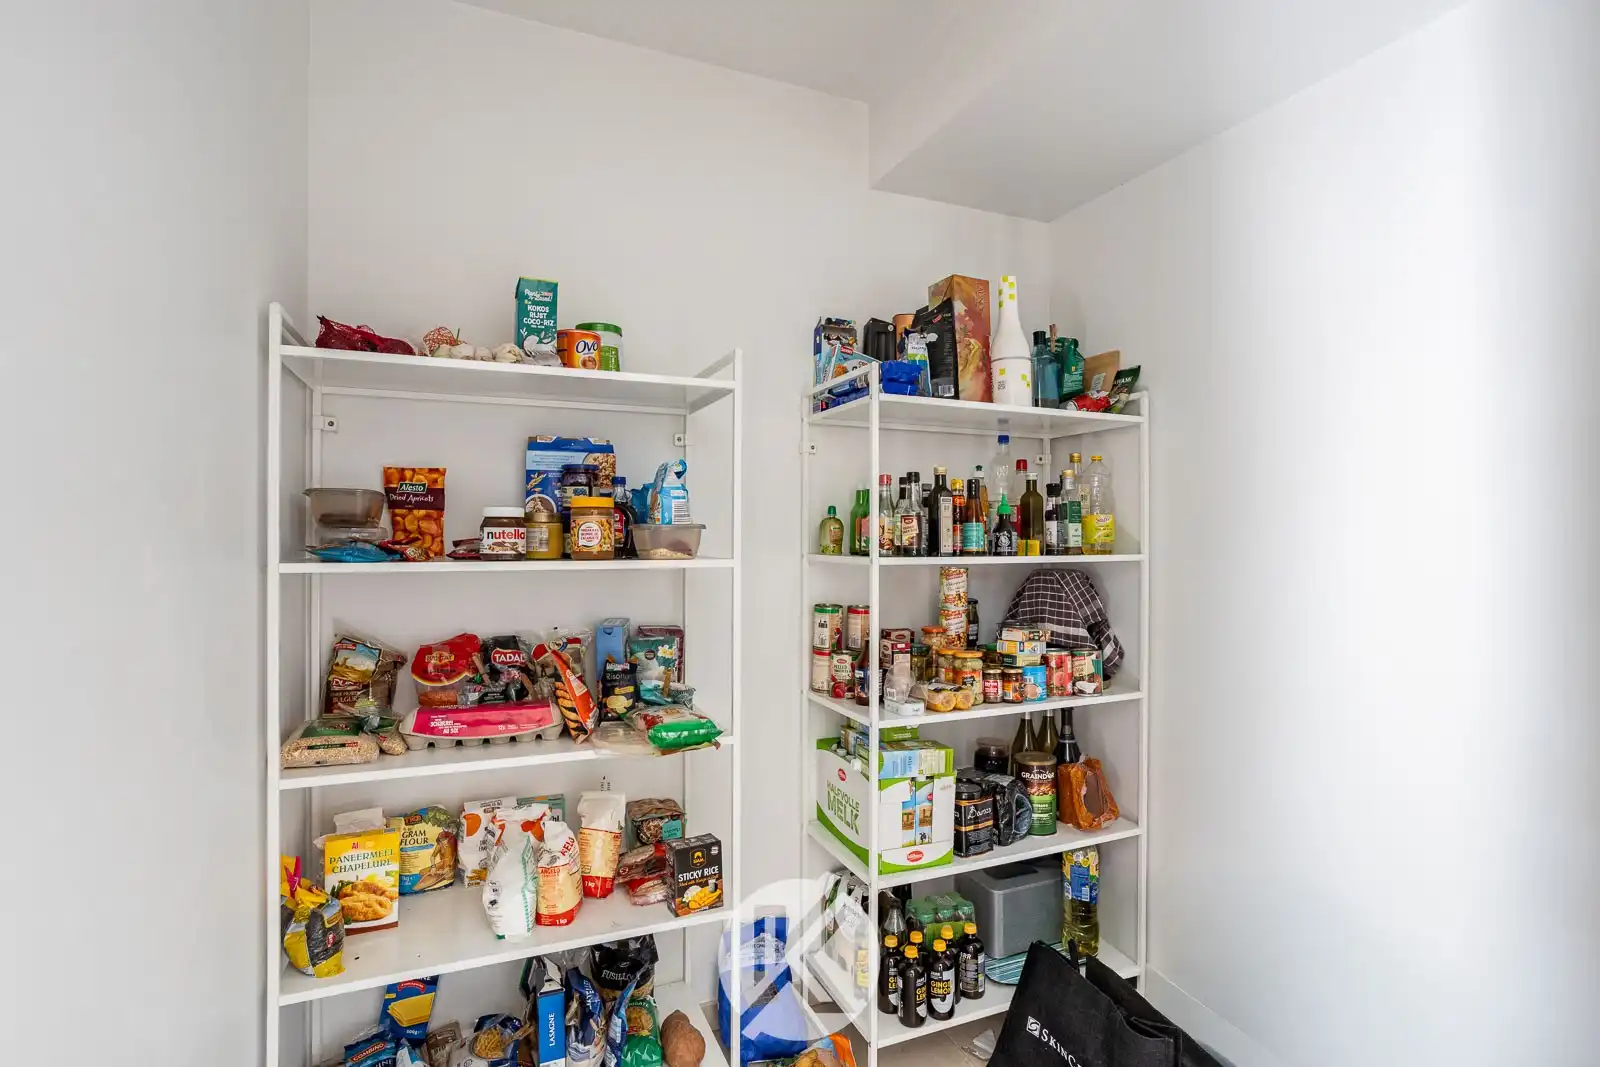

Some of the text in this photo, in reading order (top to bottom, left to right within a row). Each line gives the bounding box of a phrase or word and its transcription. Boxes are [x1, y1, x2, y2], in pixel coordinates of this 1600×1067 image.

[527, 304, 549, 313] KOKOS
[400, 483, 424, 492] Alesto
[389, 493, 434, 503] Dried Apricots
[827, 789, 860, 836] MELK
[401, 830, 427, 839] GRAM
[329, 848, 393, 865] PANEERMEEL
[331, 859, 393, 874] CHAPELURE
[678, 865, 719, 882] STICKY RICE
[1041, 1028, 1081, 1067] SKINC
